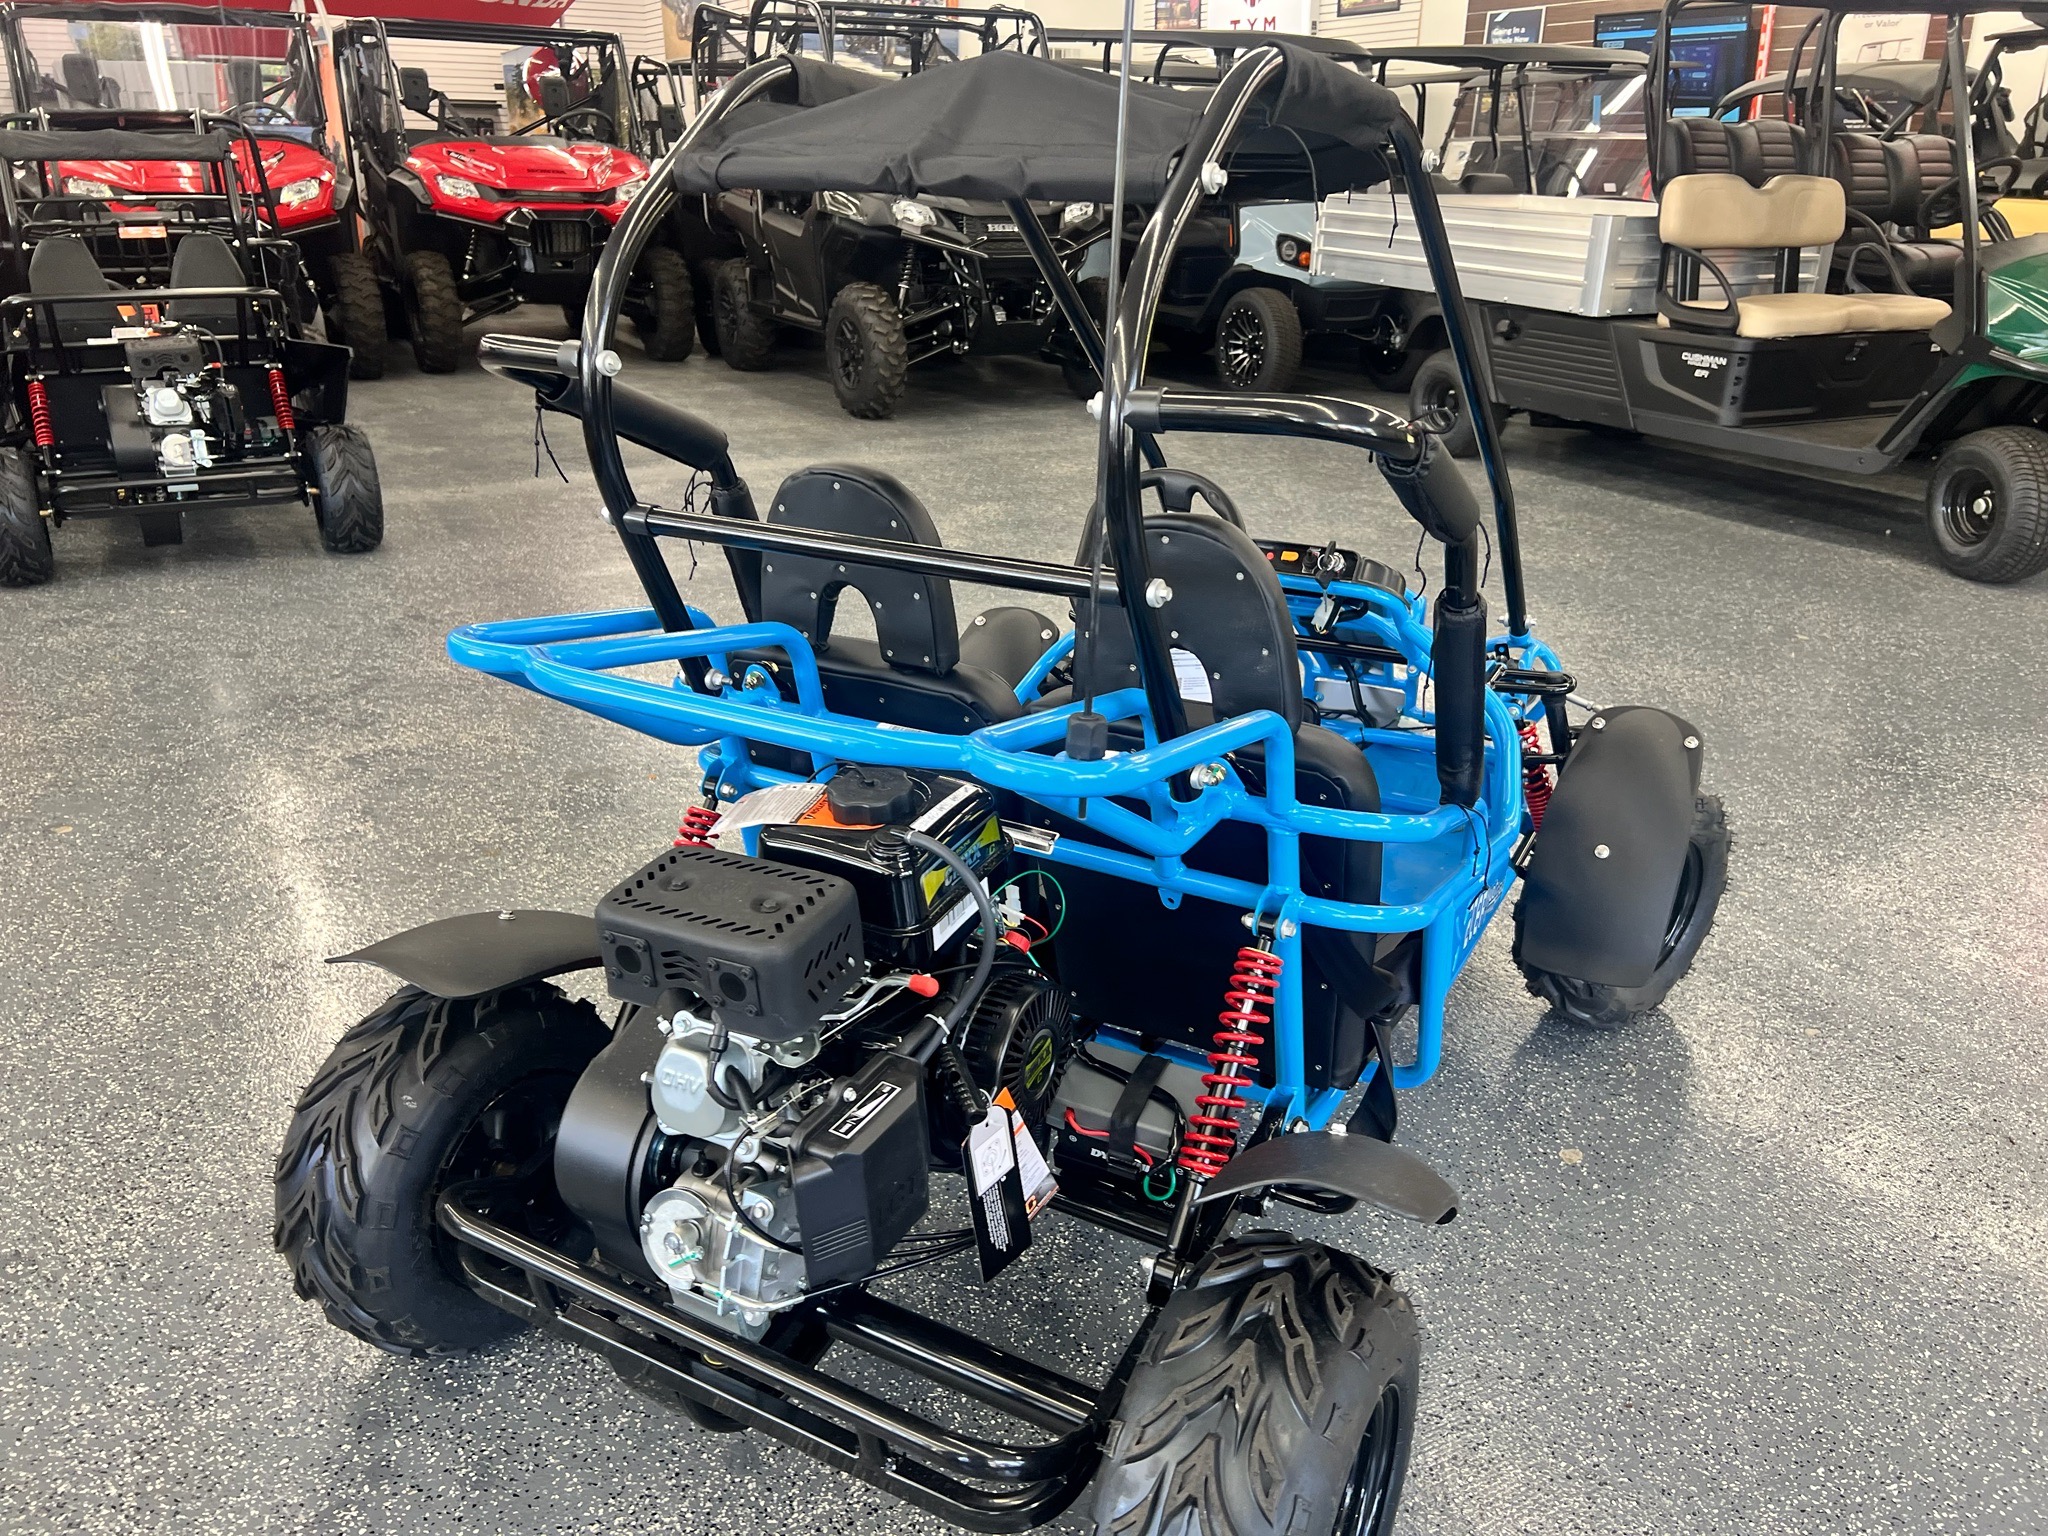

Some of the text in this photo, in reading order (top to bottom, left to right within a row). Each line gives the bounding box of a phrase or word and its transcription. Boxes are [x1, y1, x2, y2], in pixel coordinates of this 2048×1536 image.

[1230, 16, 1276, 31] TYM
[1682, 352, 1727, 365] CUSHMAN
[662, 1068, 703, 1093] OHV
